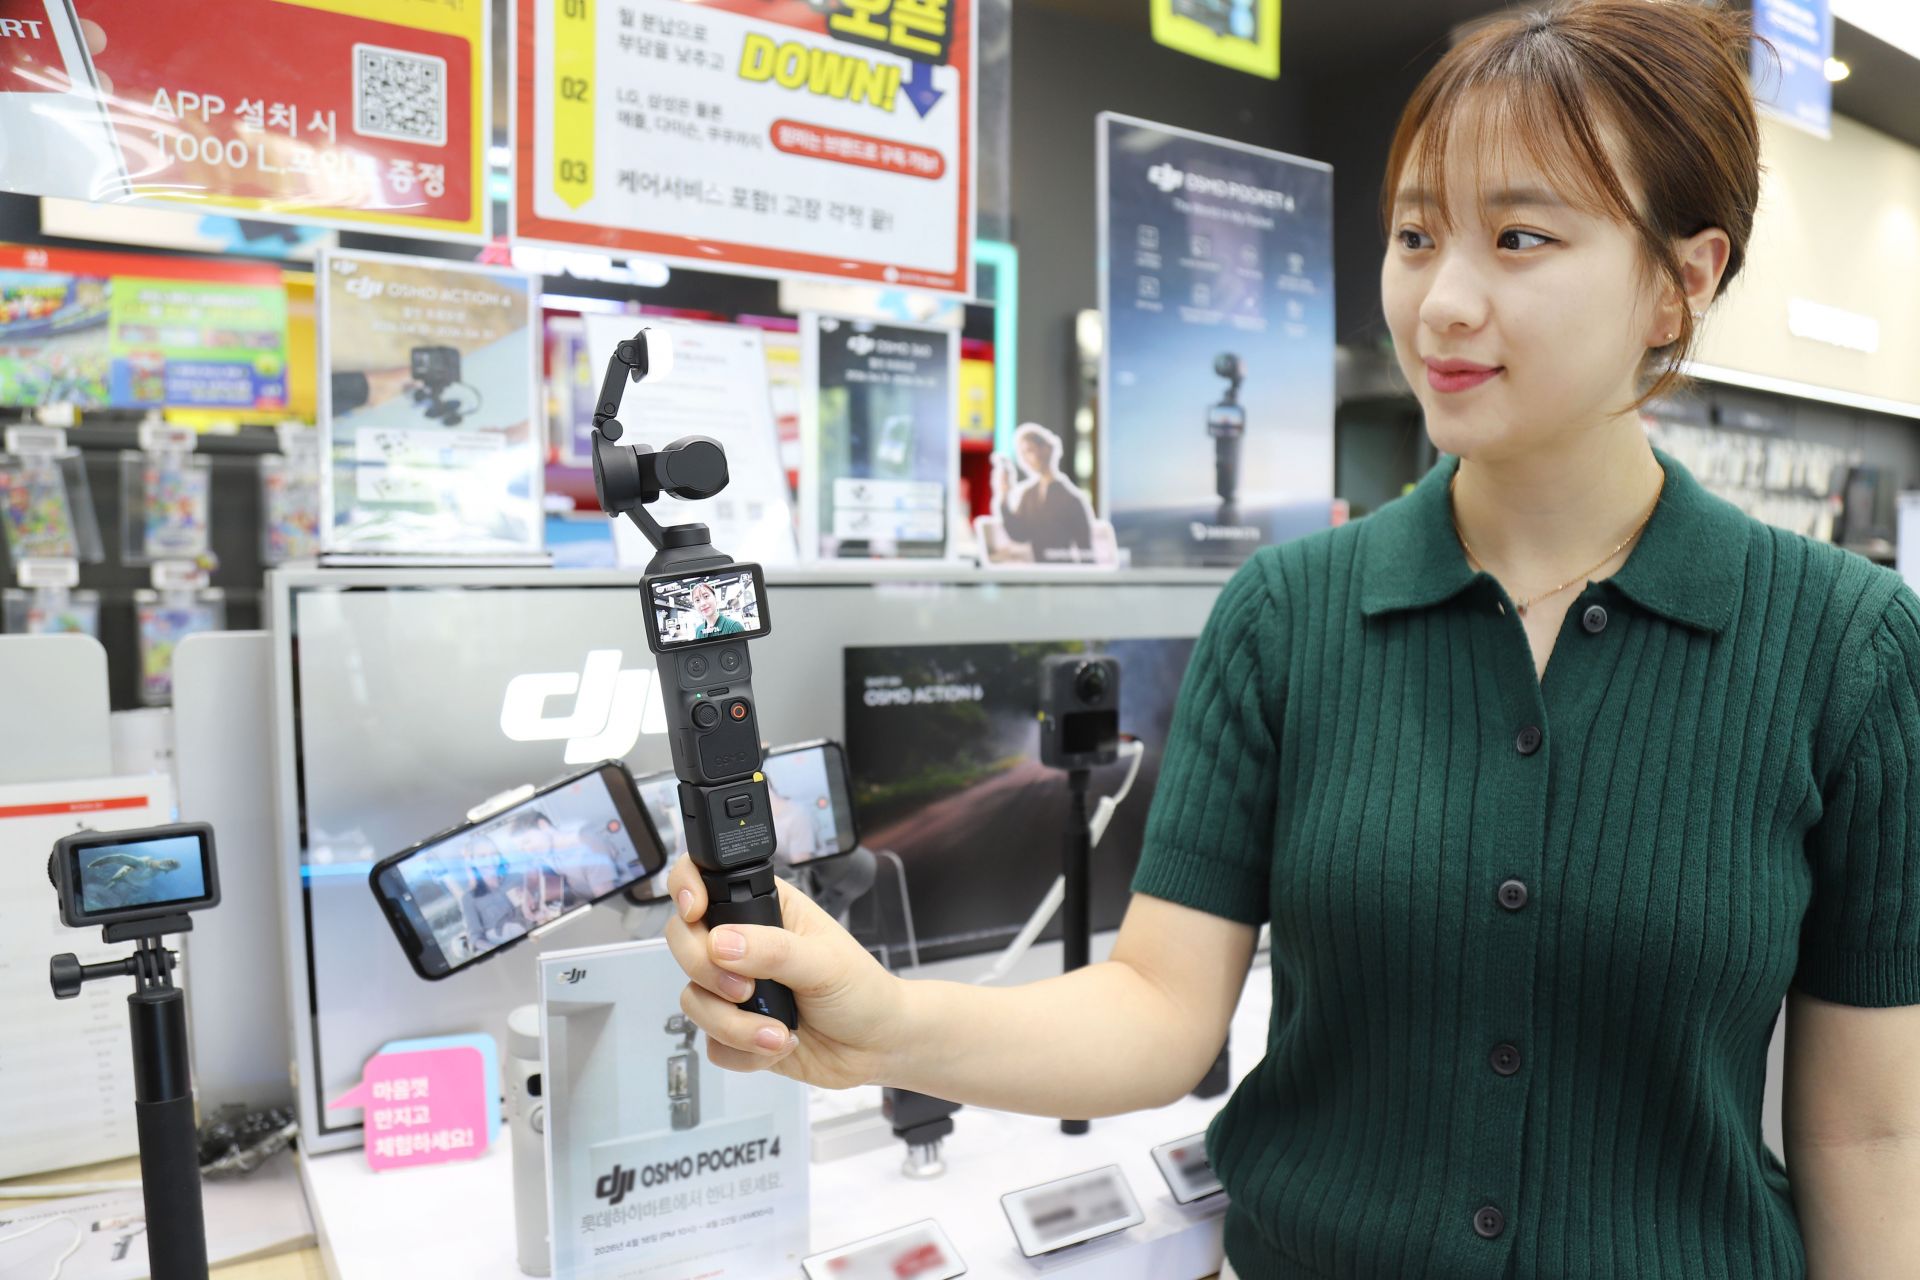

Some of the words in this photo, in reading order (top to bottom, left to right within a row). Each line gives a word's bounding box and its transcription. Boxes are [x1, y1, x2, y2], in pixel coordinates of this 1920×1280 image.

[0, 18, 42, 40] RT
[738, 32, 901, 113] DOWN!
[561, 76, 588, 102] 02
[151, 86, 226, 123] APP
[234, 97, 298, 140] 설치
[307, 109, 337, 145] 시
[386, 157, 446, 199] 증정
[560, 159, 588, 184] 03
[863, 686, 913, 707] OSMO
[913, 683, 973, 705] ACTION
[371, 1076, 430, 1102] 마음껏
[373, 1104, 431, 1131] 만지고
[374, 1127, 476, 1158] 체험하세요!
[640, 1156, 693, 1188] OSMO
[696, 1137, 768, 1176] POCKET
[768, 1135, 781, 1158] 4
